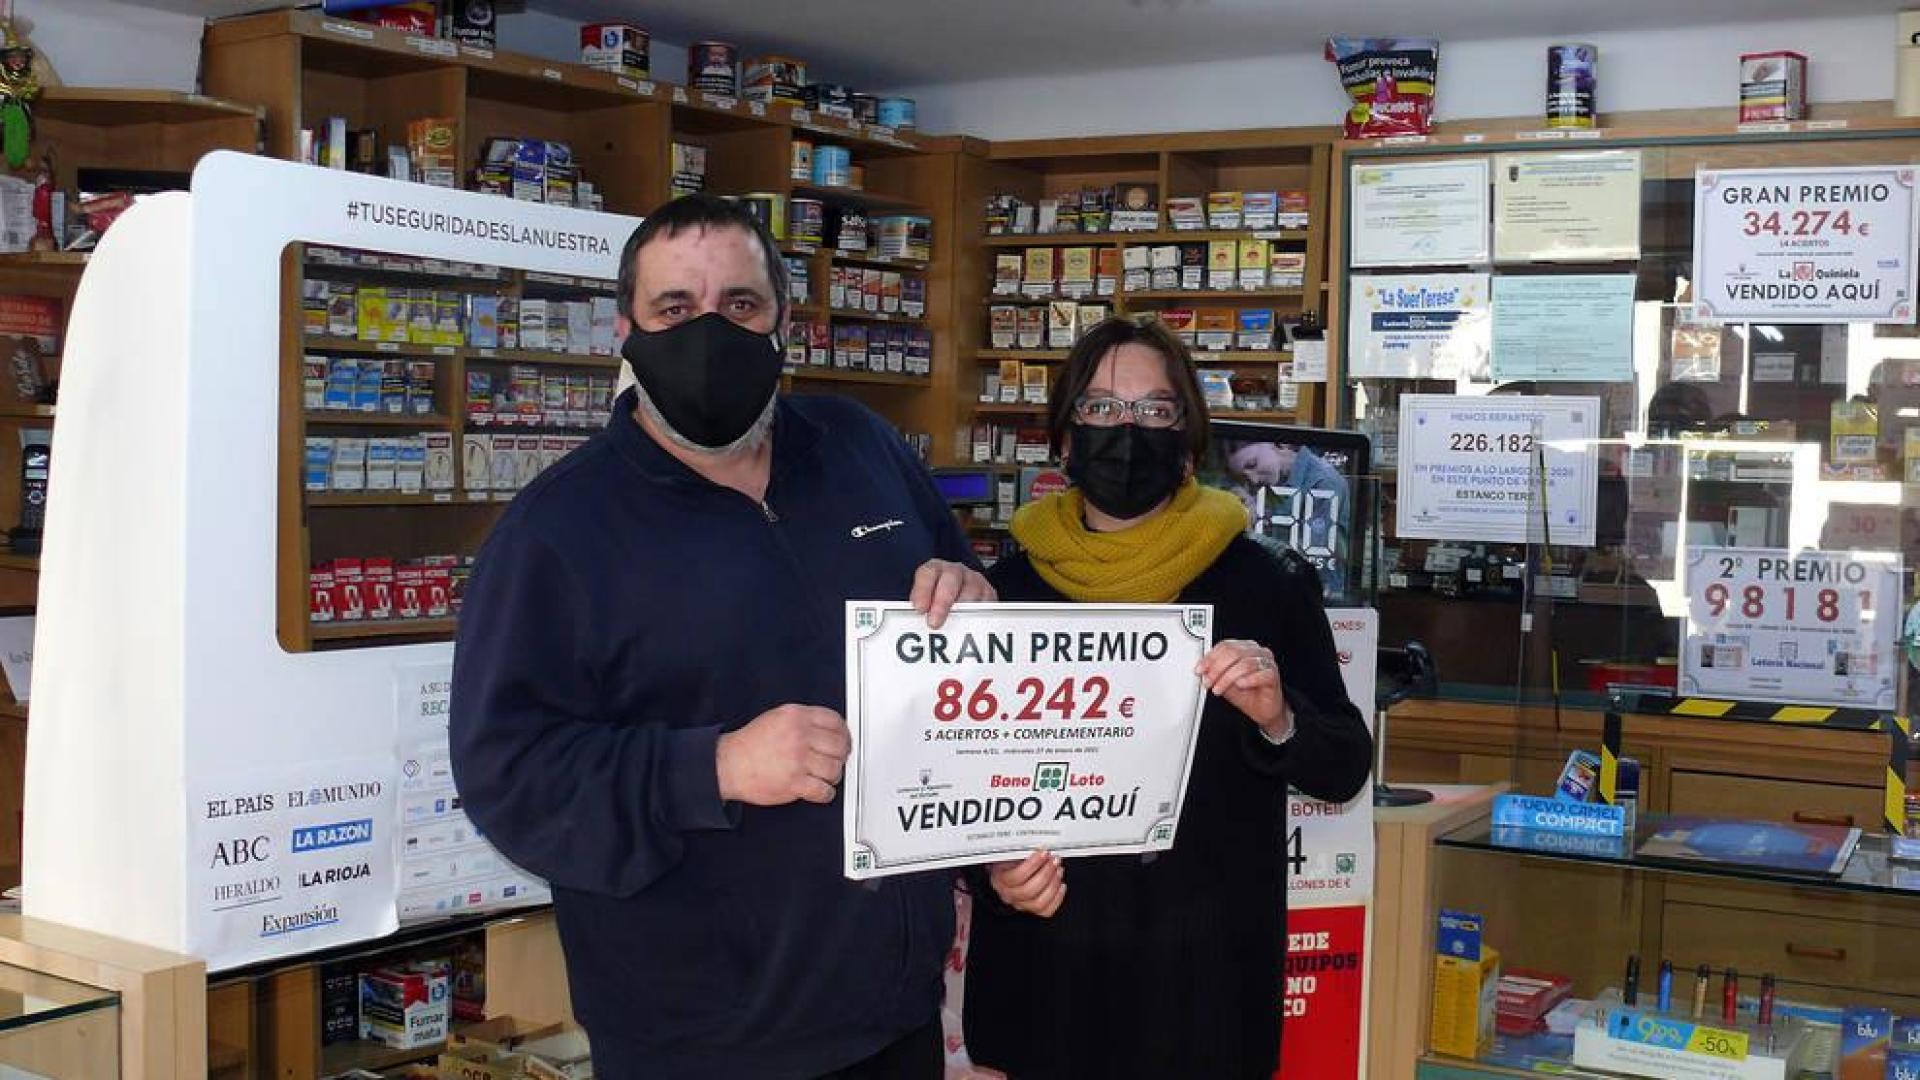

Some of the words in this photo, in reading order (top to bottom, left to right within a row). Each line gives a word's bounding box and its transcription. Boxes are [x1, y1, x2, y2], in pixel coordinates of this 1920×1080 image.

[1723, 185, 1790, 204] GRAN
[1800, 183, 1889, 203] PREMIO
[347, 200, 612, 256] #TUSEGURIDADESLANUESTRA
[1743, 210, 1851, 236] 34.274
[1858, 223, 1871, 236] €
[1778, 269, 1791, 279] La
[1815, 267, 1860, 280] Quiniela
[1726, 285, 1818, 301] VENDIDO
[1826, 278, 1880, 301] AQUÍ
[1450, 432, 1535, 453] 226.182
[1470, 476, 1504, 486] PUNTO
[1456, 490, 1504, 500] ESTANCO
[1758, 557, 1866, 584] PREMIO
[895, 631, 1014, 664] GRAN
[1030, 631, 1169, 663] PREMIO
[421, 700, 450, 716] REC
[932, 676, 1111, 722] 86.242
[1119, 697, 1136, 718] €
[924, 729, 932, 741] 5
[934, 728, 999, 741] ACIERTOS
[1013, 726, 1135, 741] COMPLEMENTARIO
[990, 774, 1031, 788] Bono
[1070, 773, 1105, 787] Loto
[207, 800, 232, 818] EL
[235, 794, 275, 814] PAÍS
[288, 791, 309, 808] EL
[323, 781, 382, 803] MUNDO
[897, 795, 1043, 833] VENDIDO
[1053, 786, 1142, 821] AQUÍ
[1512, 796, 1564, 812] NUEVO
[1568, 804, 1619, 820] CAMEL
[1536, 811, 1619, 833] COMPACT
[295, 832, 314, 847] LA
[1287, 825, 1307, 875] 4
[210, 835, 271, 869] ABC
[301, 870, 323, 887] LA
[325, 862, 371, 883] RIOJA
[1328, 879, 1343, 889] DE
[214, 875, 281, 900] HERALDO
[263, 902, 338, 933] Expansión
[409, 1012, 444, 1028] Fumar
[1857, 1023, 1878, 1038] blu
